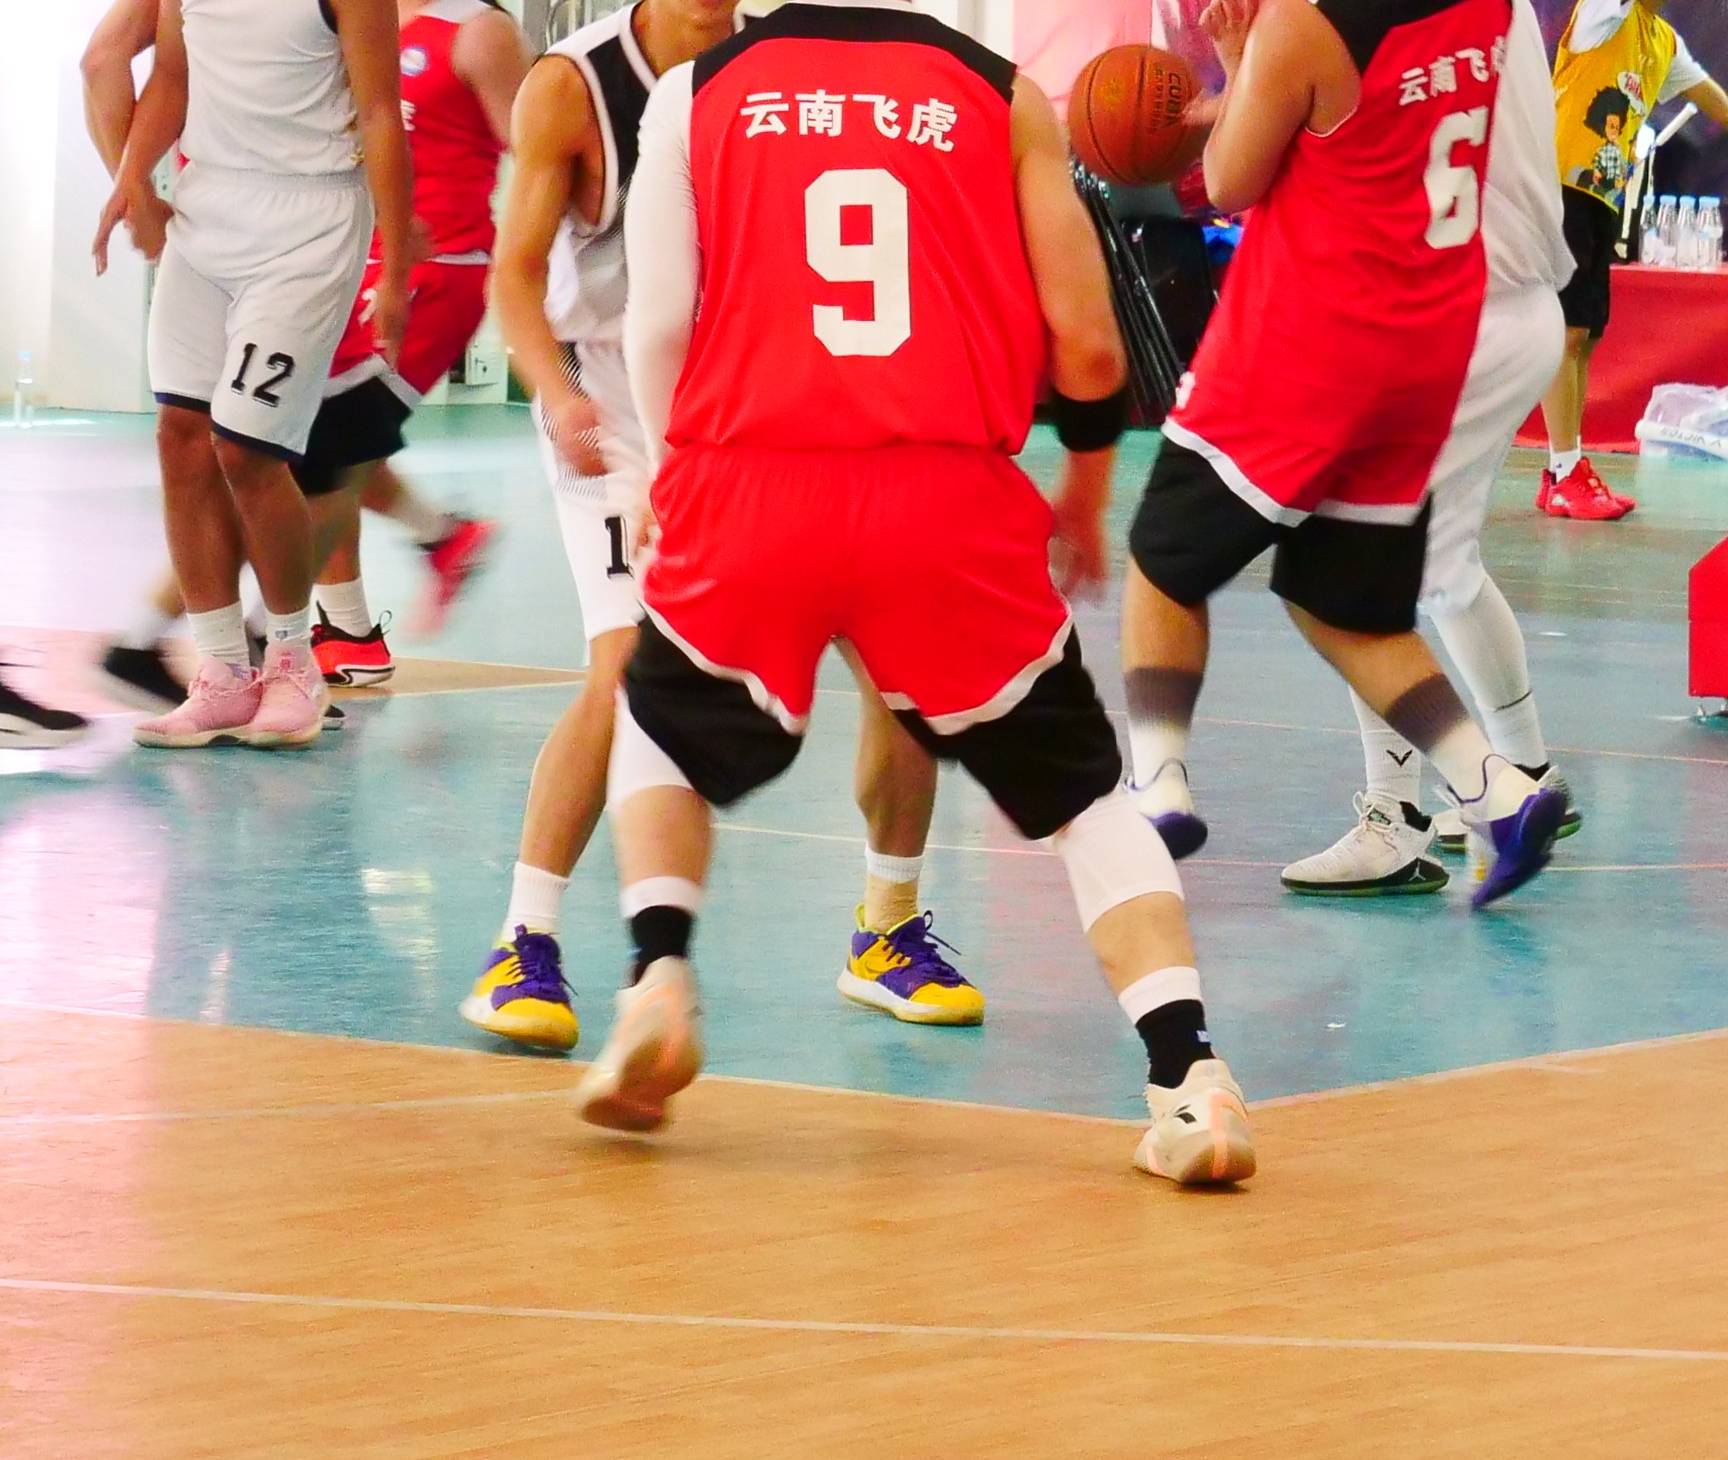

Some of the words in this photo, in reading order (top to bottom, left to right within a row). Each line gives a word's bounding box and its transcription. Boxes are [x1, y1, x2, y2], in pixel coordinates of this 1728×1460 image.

[740, 89, 958, 152] 云南飞虎
[1424, 105, 1489, 249] 6
[804, 168, 911, 356] 9
[230, 342, 296, 408] 12
